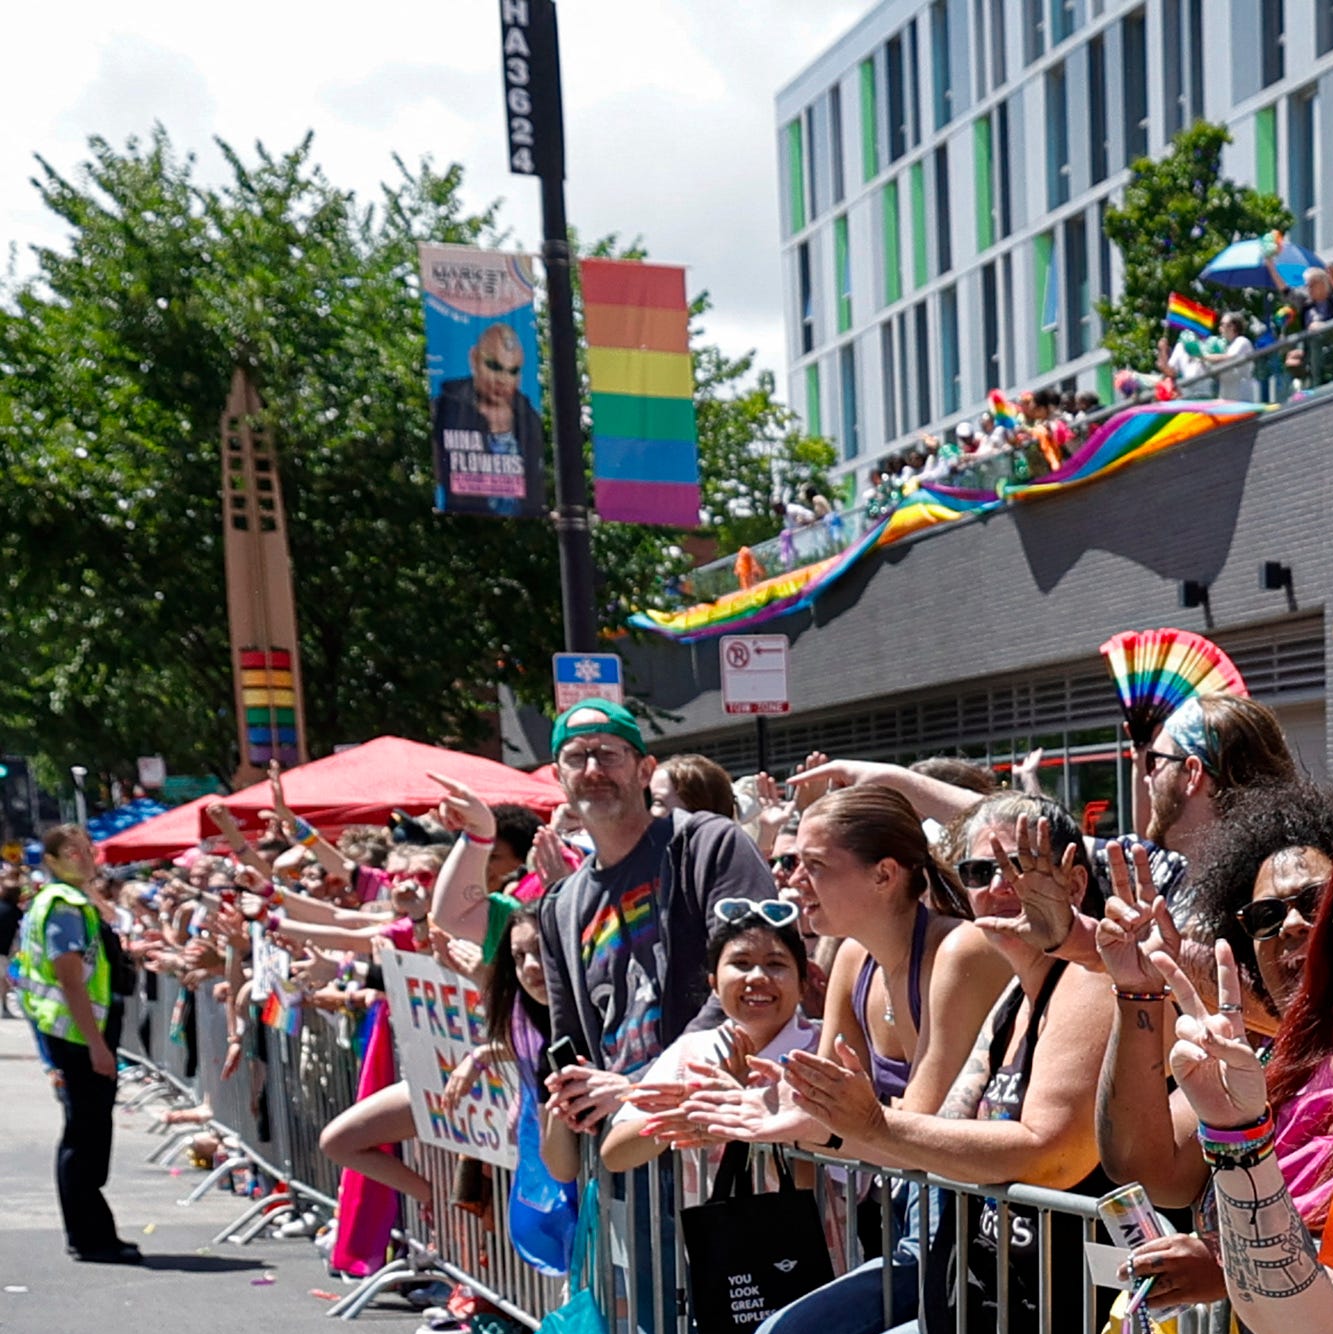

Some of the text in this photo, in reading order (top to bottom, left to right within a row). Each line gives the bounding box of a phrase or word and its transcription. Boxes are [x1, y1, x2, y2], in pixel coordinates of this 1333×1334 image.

[443, 429, 484, 452] NINA
[450, 451, 525, 475] FLOWERS
[405, 976, 488, 1046] FREE
[435, 1047, 510, 1110] MM
[424, 1089, 500, 1151] HUGS
[728, 1273, 752, 1286] YOU
[729, 1286, 760, 1298] LOOK
[731, 1298, 765, 1311] GREAT
